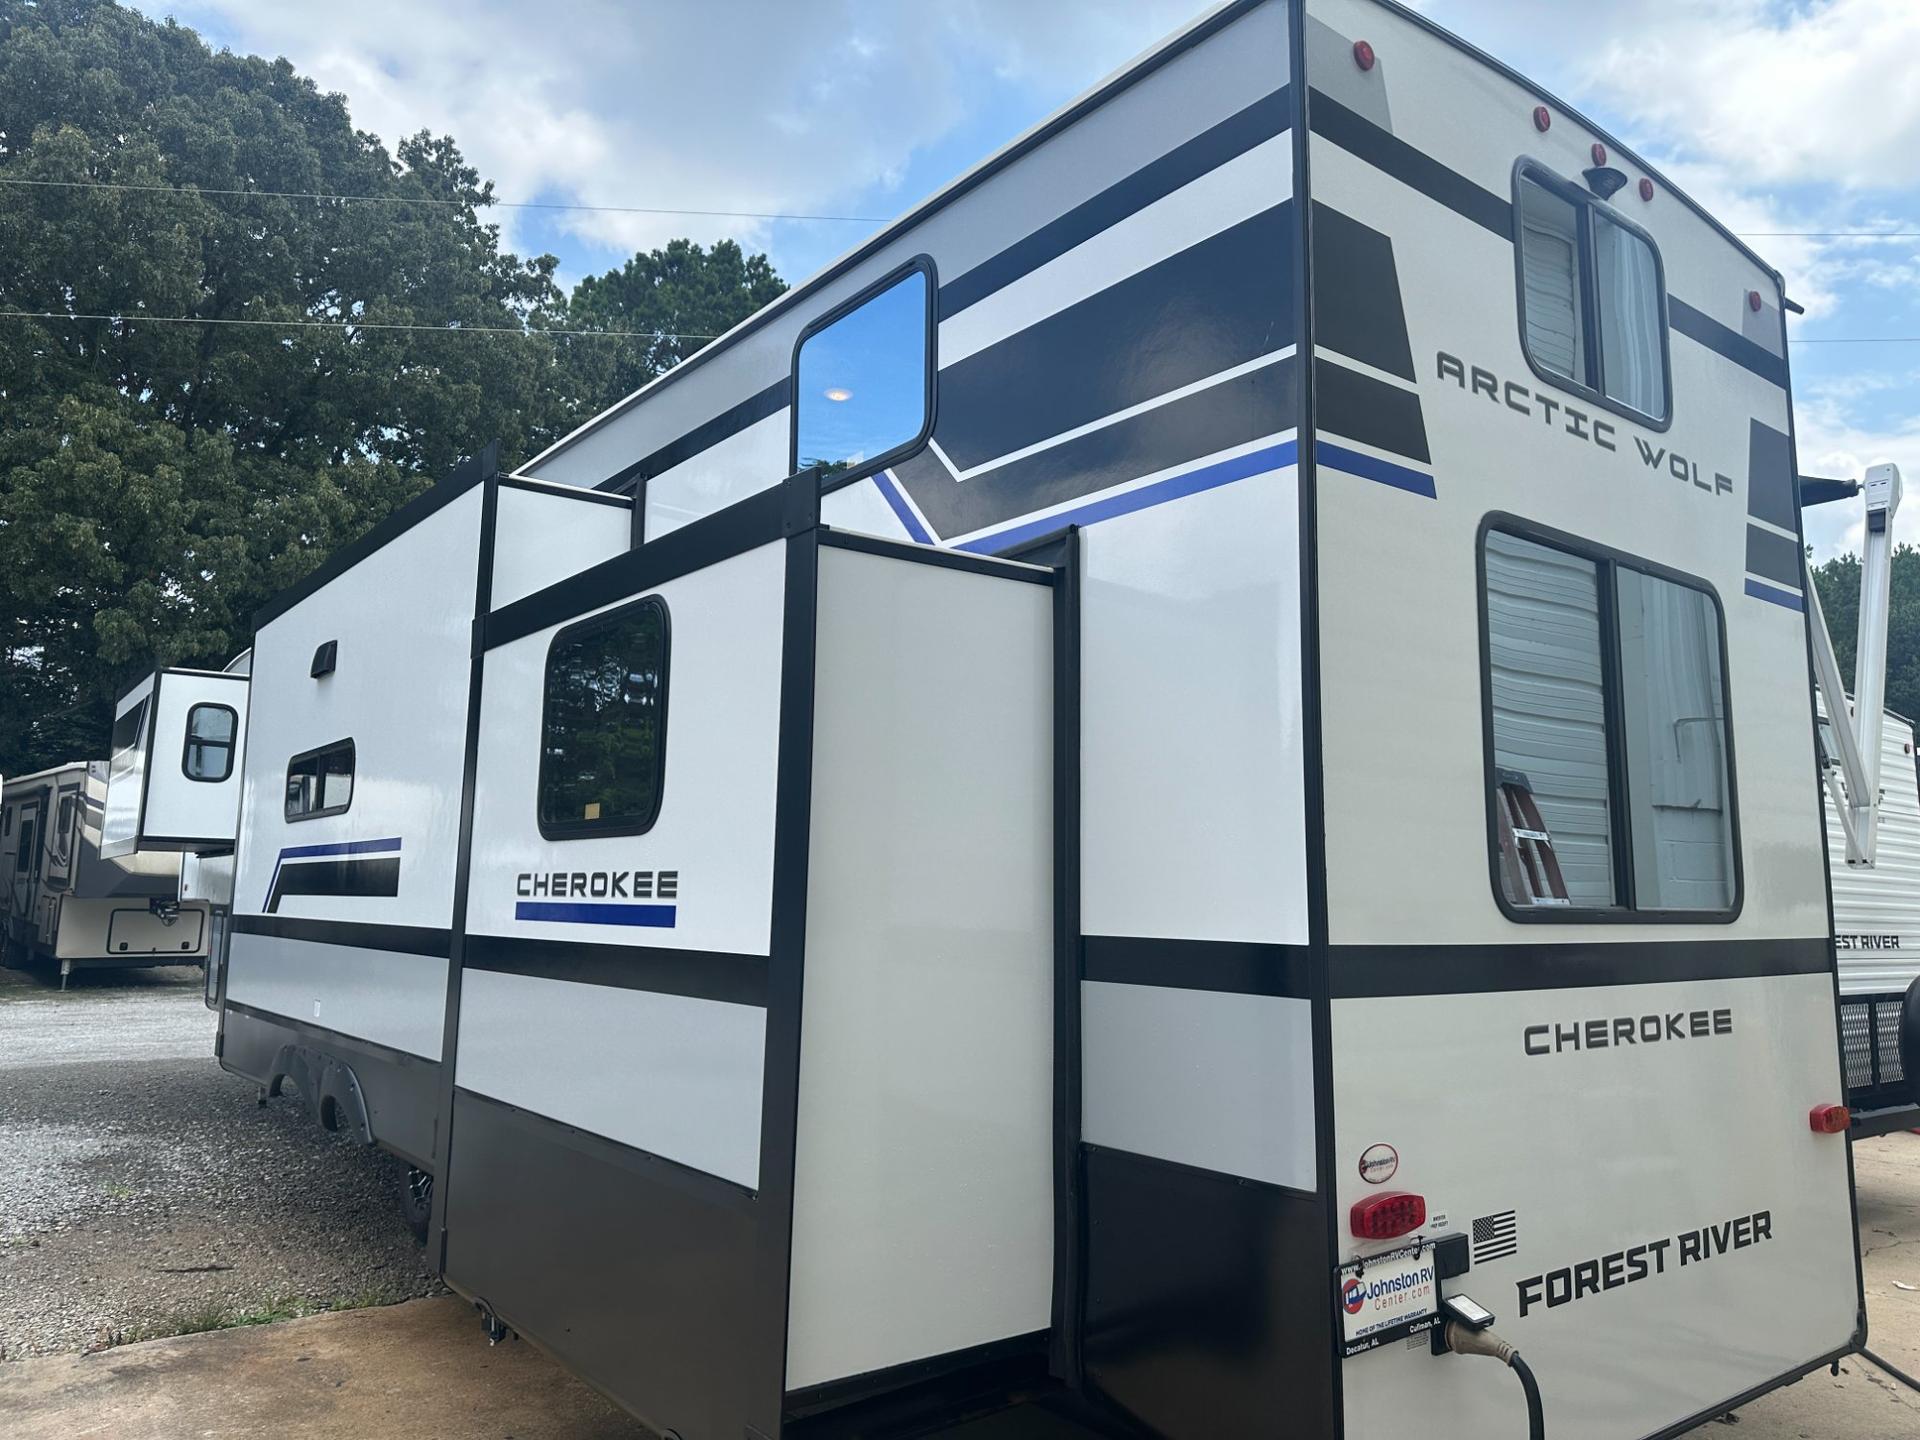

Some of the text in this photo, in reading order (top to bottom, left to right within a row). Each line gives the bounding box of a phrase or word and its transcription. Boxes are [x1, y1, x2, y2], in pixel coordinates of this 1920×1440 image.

[1437, 351, 1733, 496] ARCTIC WOLF
[516, 871, 678, 899] CHEROKEE
[1861, 935, 1900, 949] RIVER
[1523, 1008, 1733, 1056] CHEROKEE
[1515, 1210, 1772, 1318] FOREST RIVER
[1367, 1265, 1434, 1300] Johnston RV
[1374, 1285, 1430, 1311] Center.com
[1433, 1316, 1441, 1325] AL
[1371, 1337, 1380, 1347] AL
